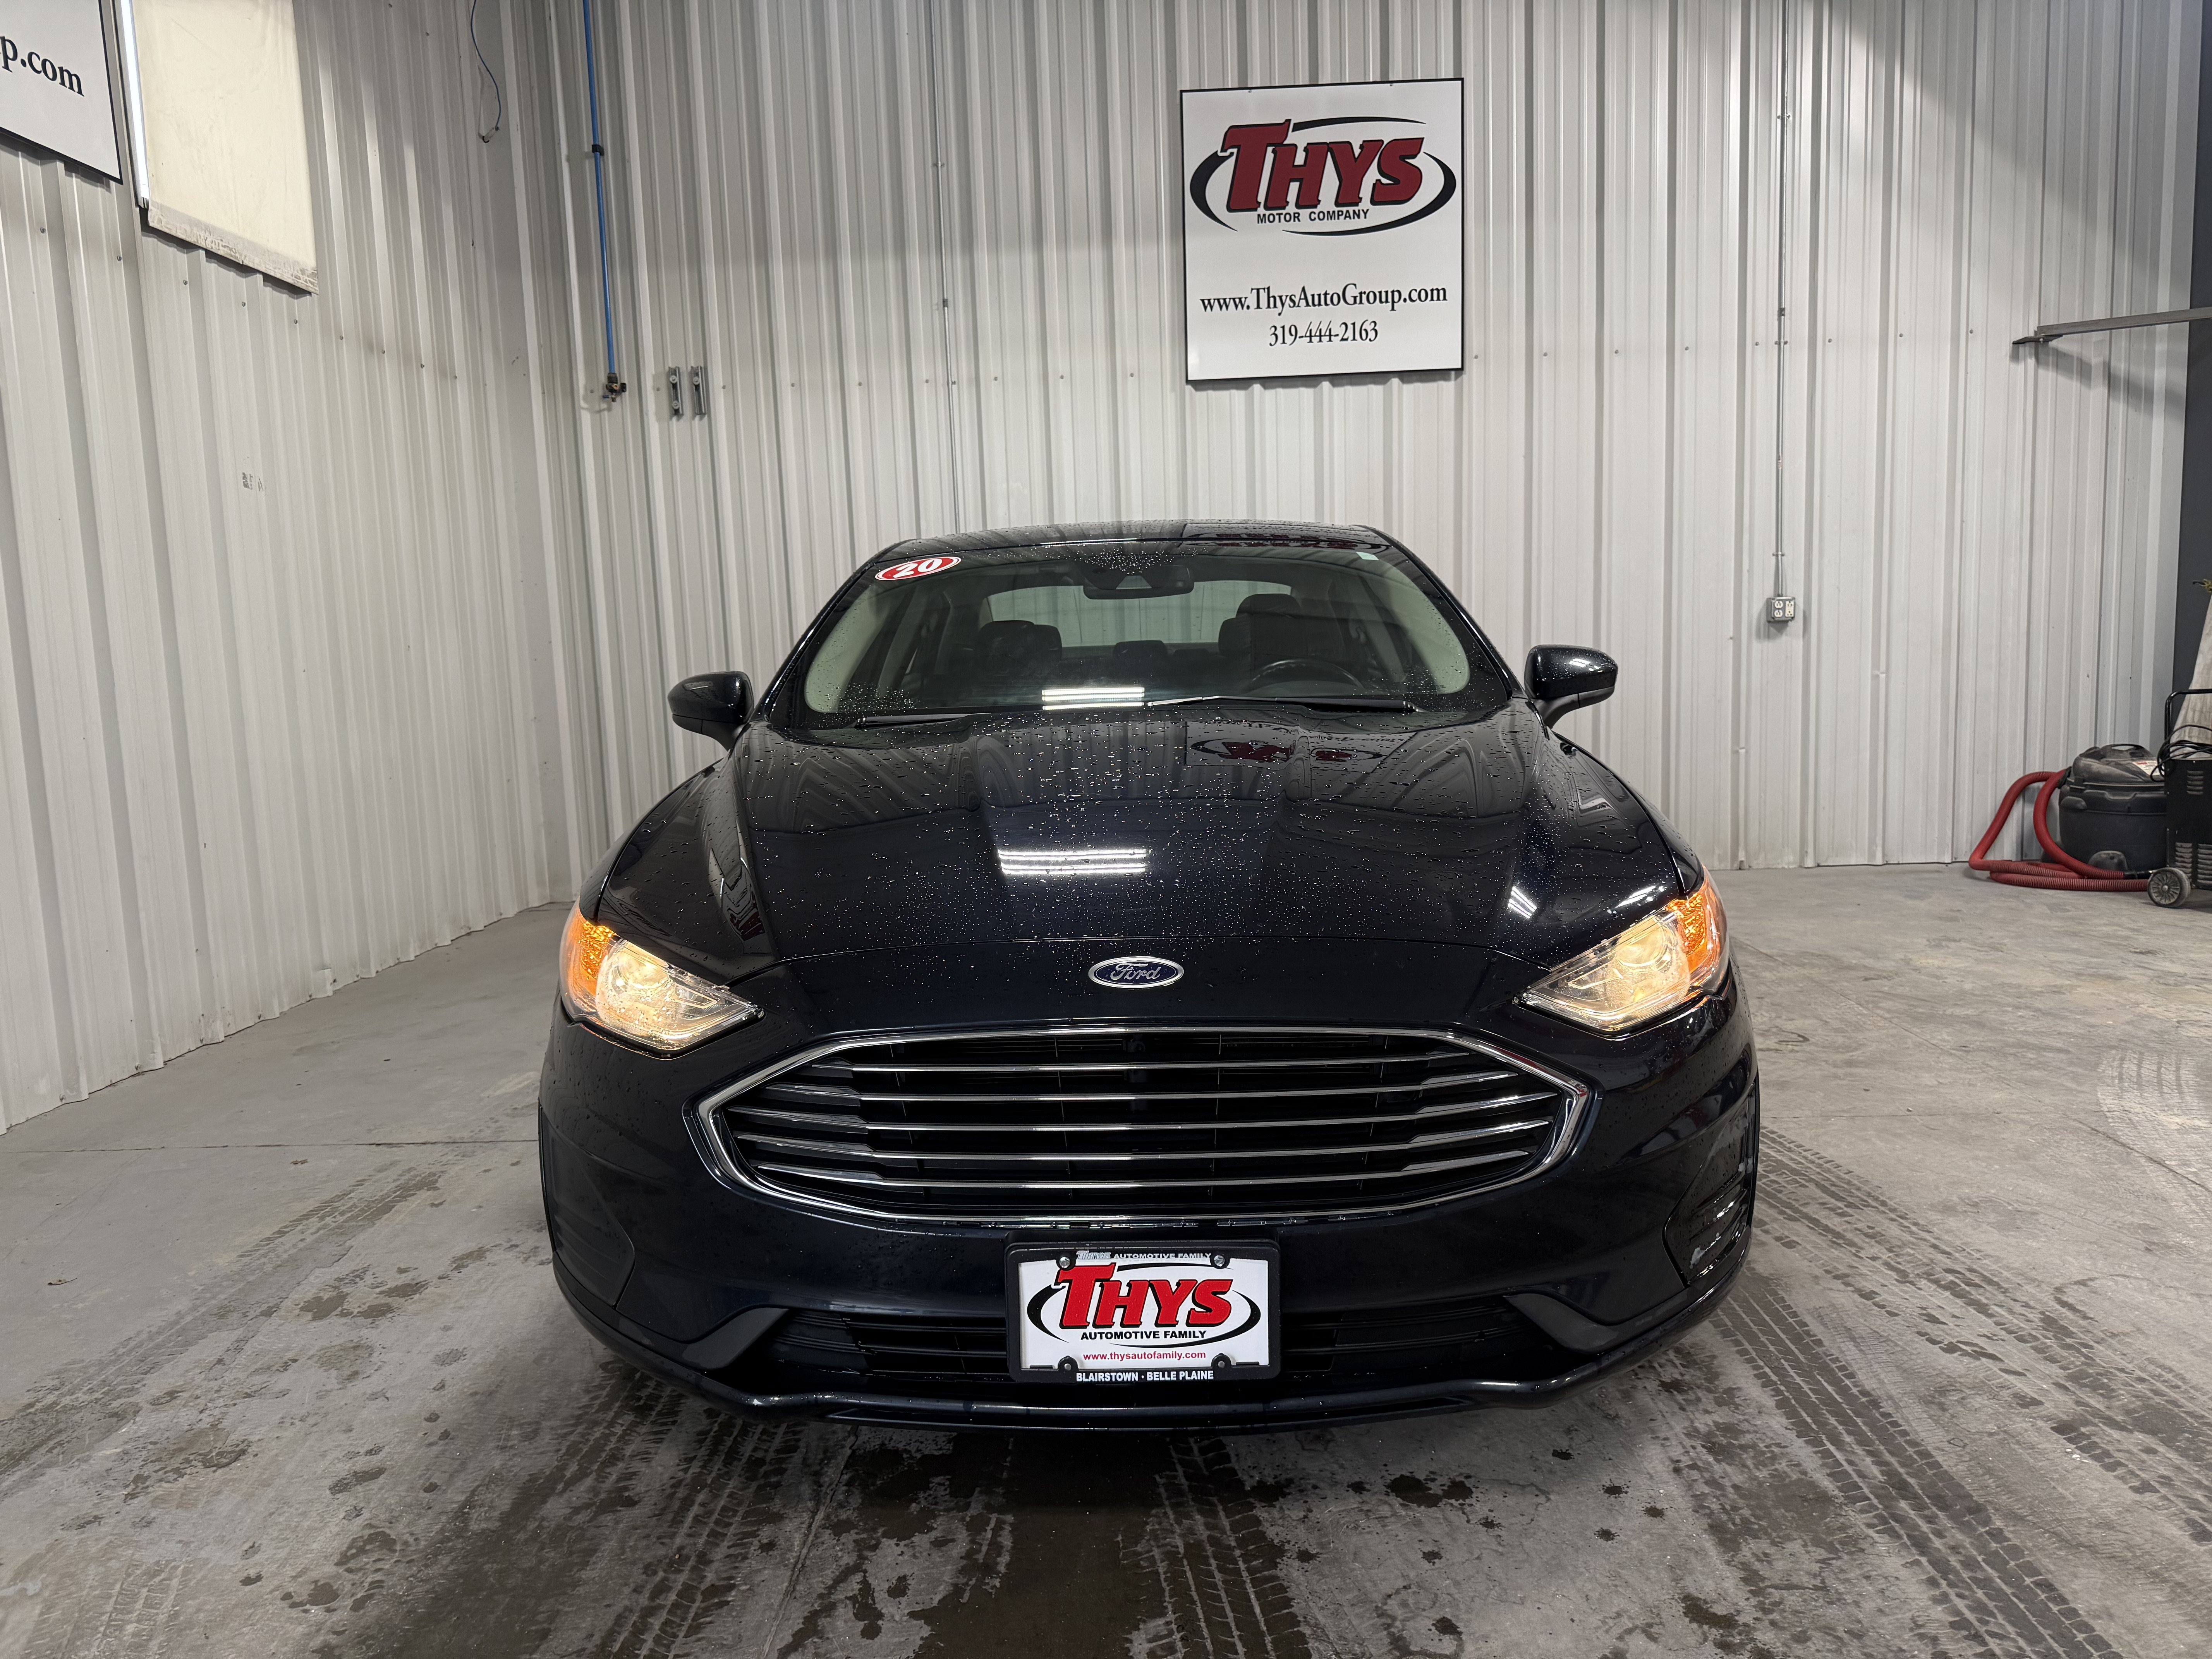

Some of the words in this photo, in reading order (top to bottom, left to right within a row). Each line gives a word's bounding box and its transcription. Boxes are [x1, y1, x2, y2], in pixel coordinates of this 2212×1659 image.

[1221, 119, 1424, 212] THYS
[1257, 213, 1301, 224] MOTOR
[1309, 209, 1369, 222] COMPANY
[1200, 283, 1448, 316] www.ThysAutoGroup.com
[1269, 319, 1378, 347] 319-444-2163
[893, 558, 943, 578] 20
[1110, 963, 1161, 980] Ford
[1057, 1263, 1233, 1328] THYS
[1080, 1331, 1160, 1340] AUTOMOTIVE
[1163, 1331, 1207, 1339] FAMILY
[1083, 1351, 1206, 1361] www.thysautofamily.com
[1076, 1372, 1139, 1382] BLAIRSTOWN
[1147, 1372, 1177, 1381] BELLE
[1179, 1371, 1214, 1380] PLAINE
